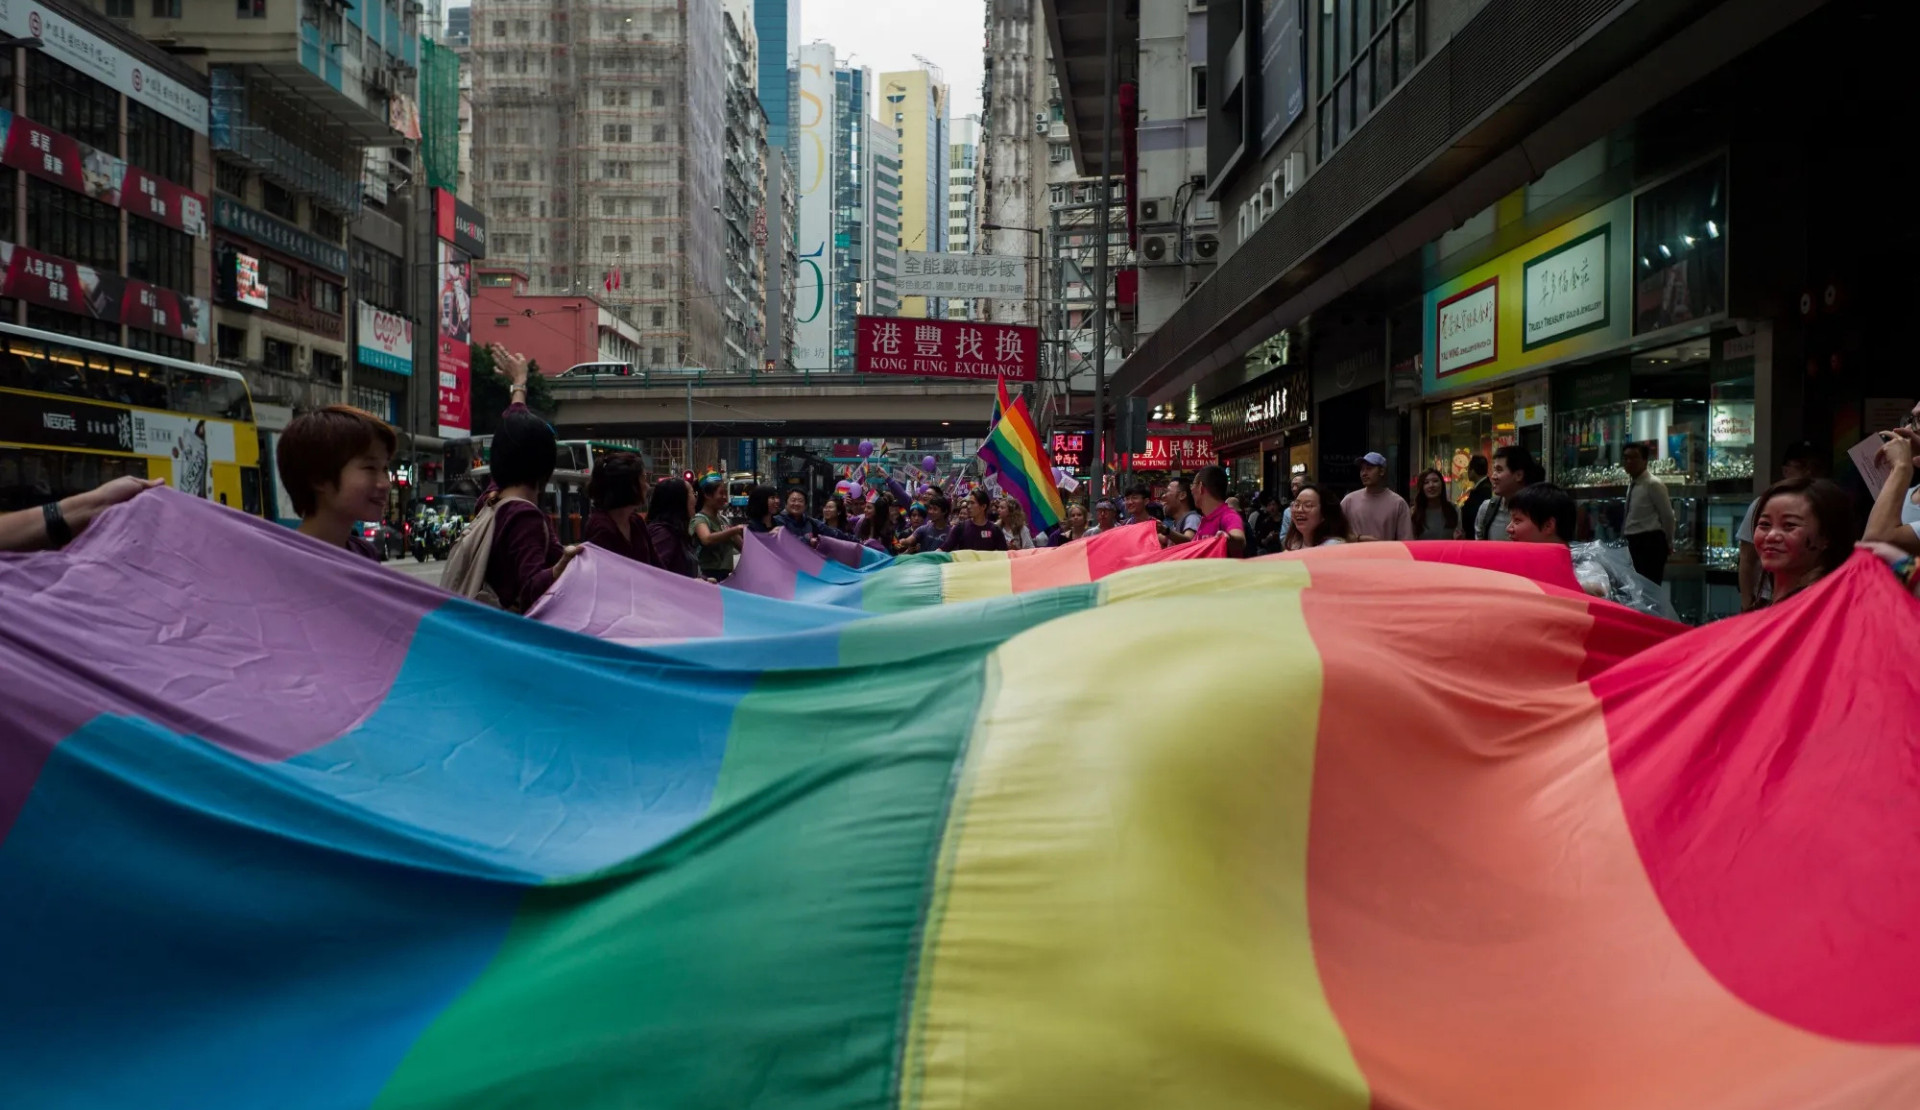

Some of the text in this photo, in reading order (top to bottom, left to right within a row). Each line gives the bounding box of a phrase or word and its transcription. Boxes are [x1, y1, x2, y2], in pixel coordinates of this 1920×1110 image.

[43, 153, 63, 176] 保險
[24, 256, 65, 282] 人身意外
[904, 256, 1016, 278] 全能數碼影像
[49, 281, 69, 301] 保險
[1544, 312, 1566, 327] TREASURY
[872, 322, 1024, 363] 港豐找換
[870, 357, 1024, 377] KONG FUNG EXCHANGE
[1055, 453, 1079, 465] 中西大
